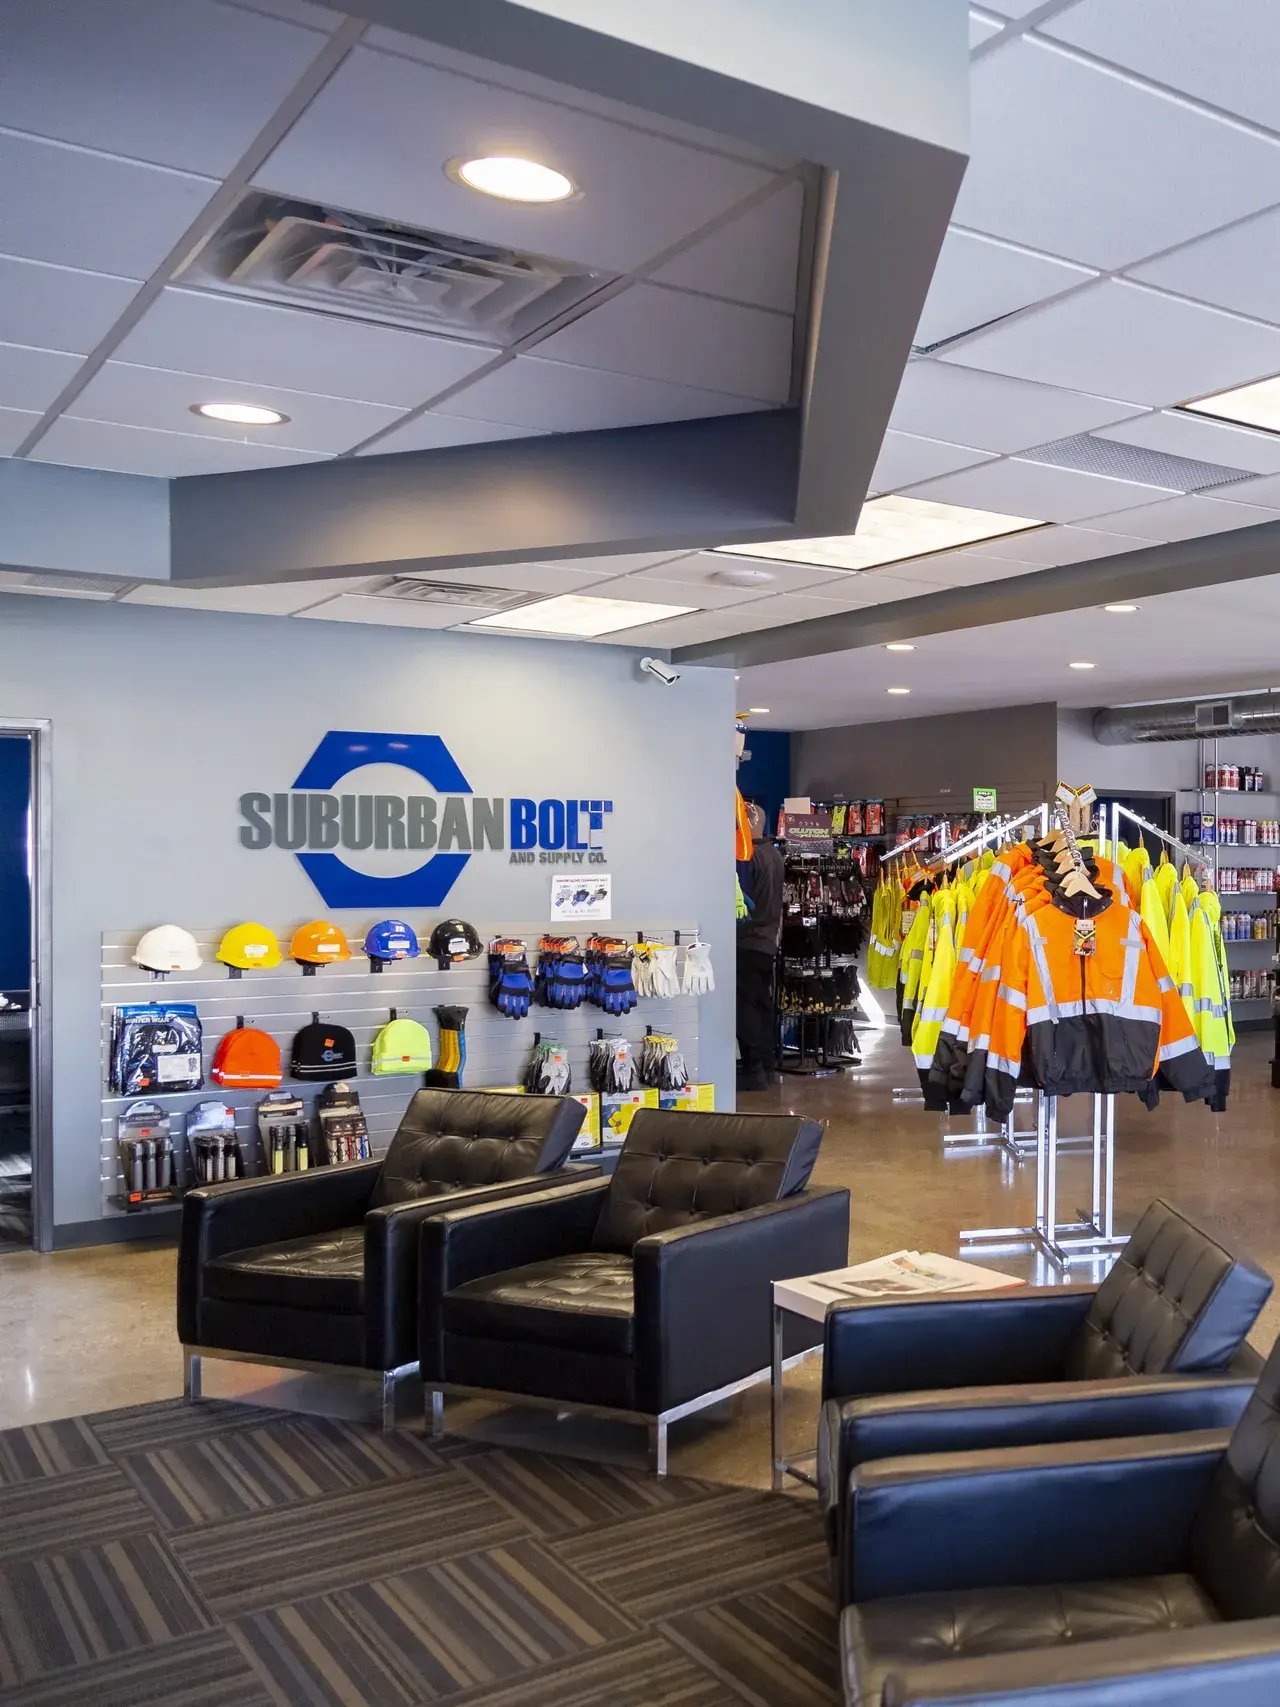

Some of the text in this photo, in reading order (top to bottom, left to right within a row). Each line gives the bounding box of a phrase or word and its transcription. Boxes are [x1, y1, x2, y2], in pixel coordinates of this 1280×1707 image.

[239, 792, 614, 851] SUBURBAN BOLT
[509, 851, 608, 864] AND SUPPLY CO.
